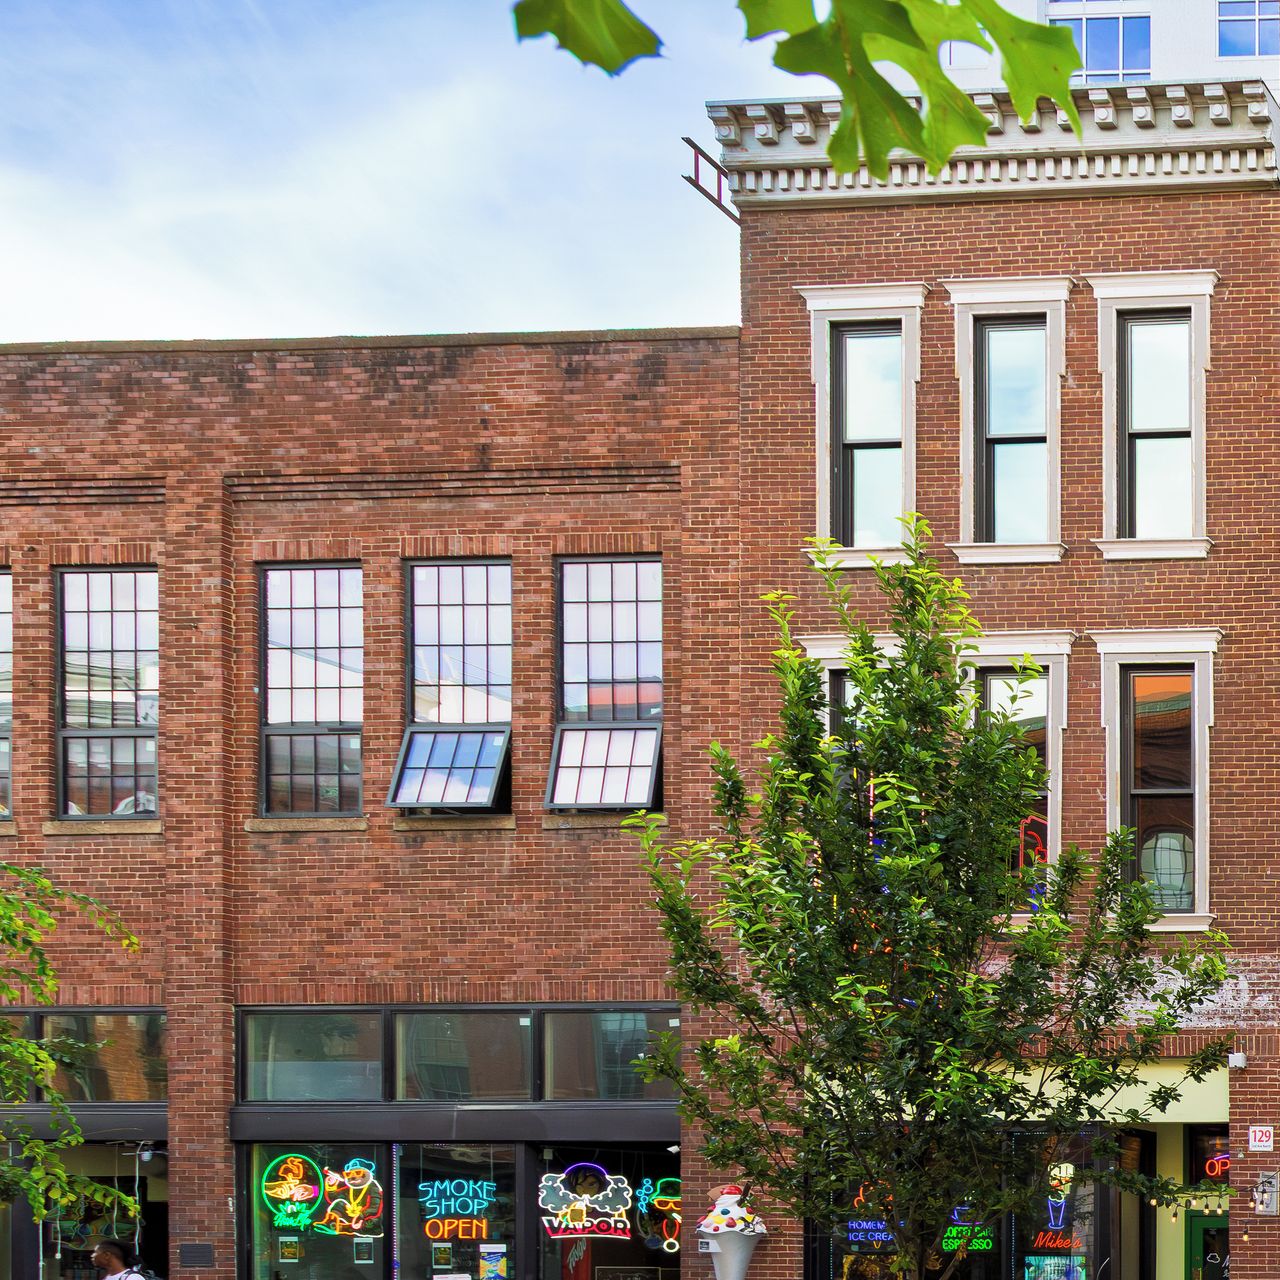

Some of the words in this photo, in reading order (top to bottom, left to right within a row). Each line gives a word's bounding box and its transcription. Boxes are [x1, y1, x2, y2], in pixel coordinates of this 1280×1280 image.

[1251, 1129, 1271, 1143] 129
[418, 1179, 496, 1201] SMOKE
[425, 1197, 489, 1218] SHOP
[425, 1218, 488, 1239] OPEN
[542, 1216, 631, 1238] VAPOR
[849, 1232, 865, 1241] ICE
[868, 1232, 896, 1241] CREA
[1032, 1231, 1082, 1249] Mike's
